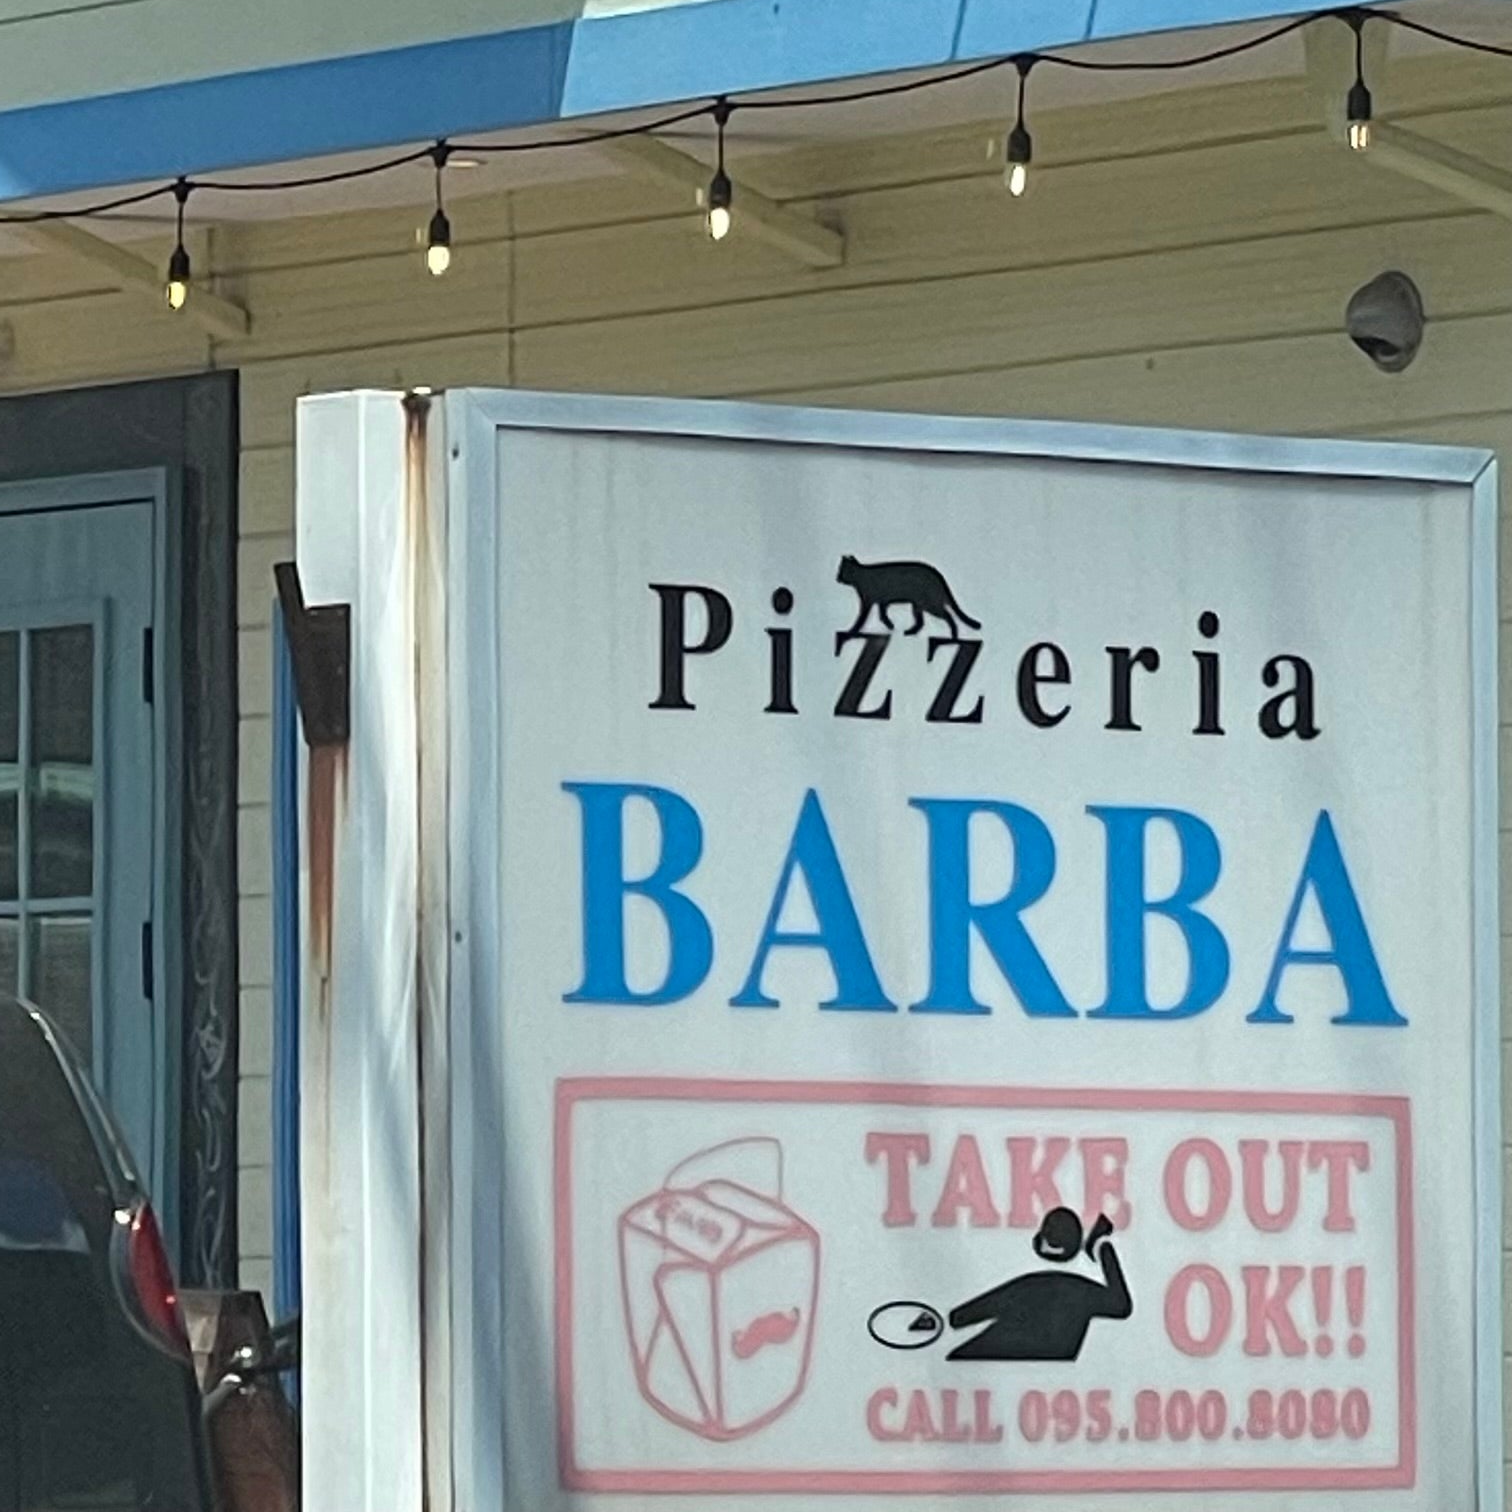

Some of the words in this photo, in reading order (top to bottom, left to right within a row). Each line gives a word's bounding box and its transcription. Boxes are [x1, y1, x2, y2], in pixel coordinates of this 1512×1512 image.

[648, 583, 1322, 740] Pizzeria
[561, 782, 1409, 1027] BARBA
[864, 1132, 1131, 1231] TAKE
[1163, 1137, 1371, 1233] OUT
[1163, 1263, 1366, 1358] OK!!
[866, 1385, 1004, 1443] CALL
[1018, 1387, 1372, 1443] 095.800.8080
